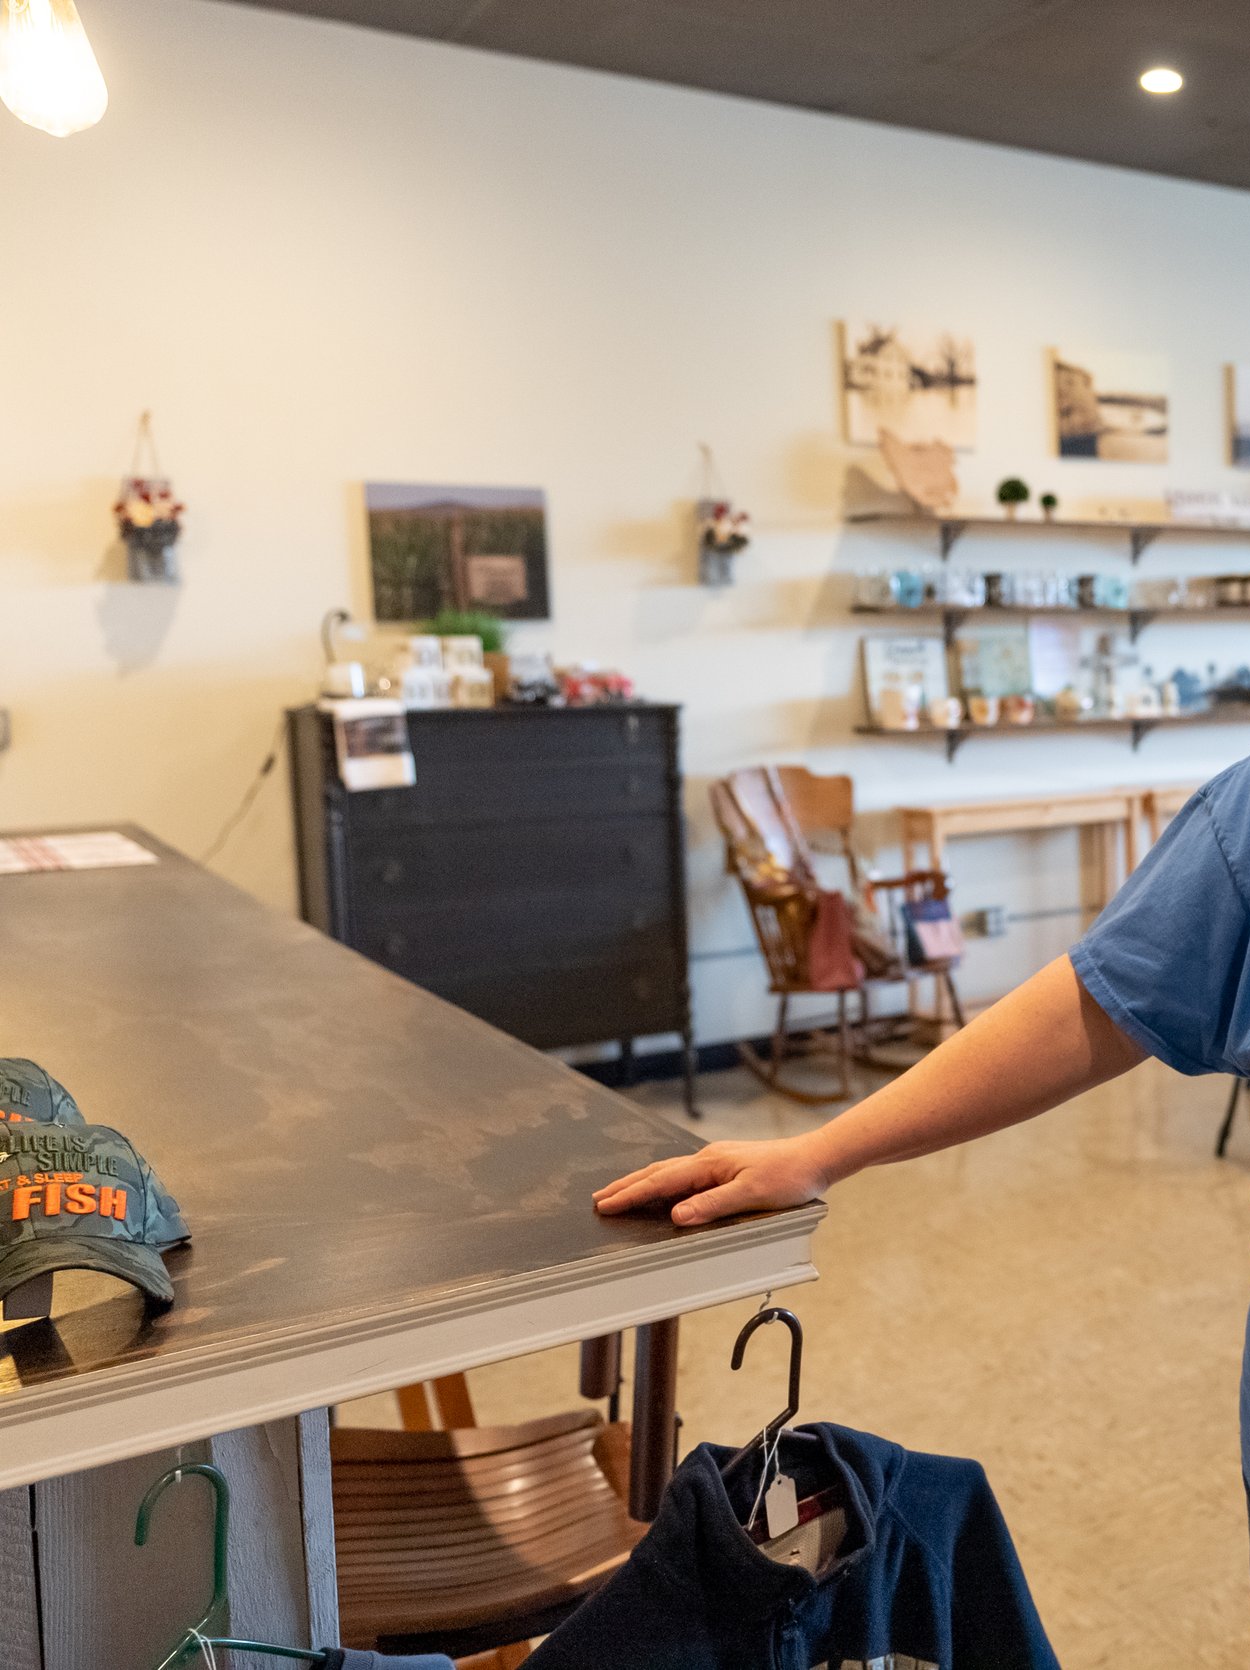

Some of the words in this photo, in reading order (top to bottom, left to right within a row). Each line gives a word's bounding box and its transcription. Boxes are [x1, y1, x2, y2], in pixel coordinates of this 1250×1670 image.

[9, 1134, 59, 1153] LIFE
[63, 1135, 88, 1153] IS
[37, 1152, 119, 1177] SIMPLE
[16, 1174, 32, 1186] &
[33, 1171, 85, 1184] SLEEP
[12, 1182, 127, 1221] FISH
